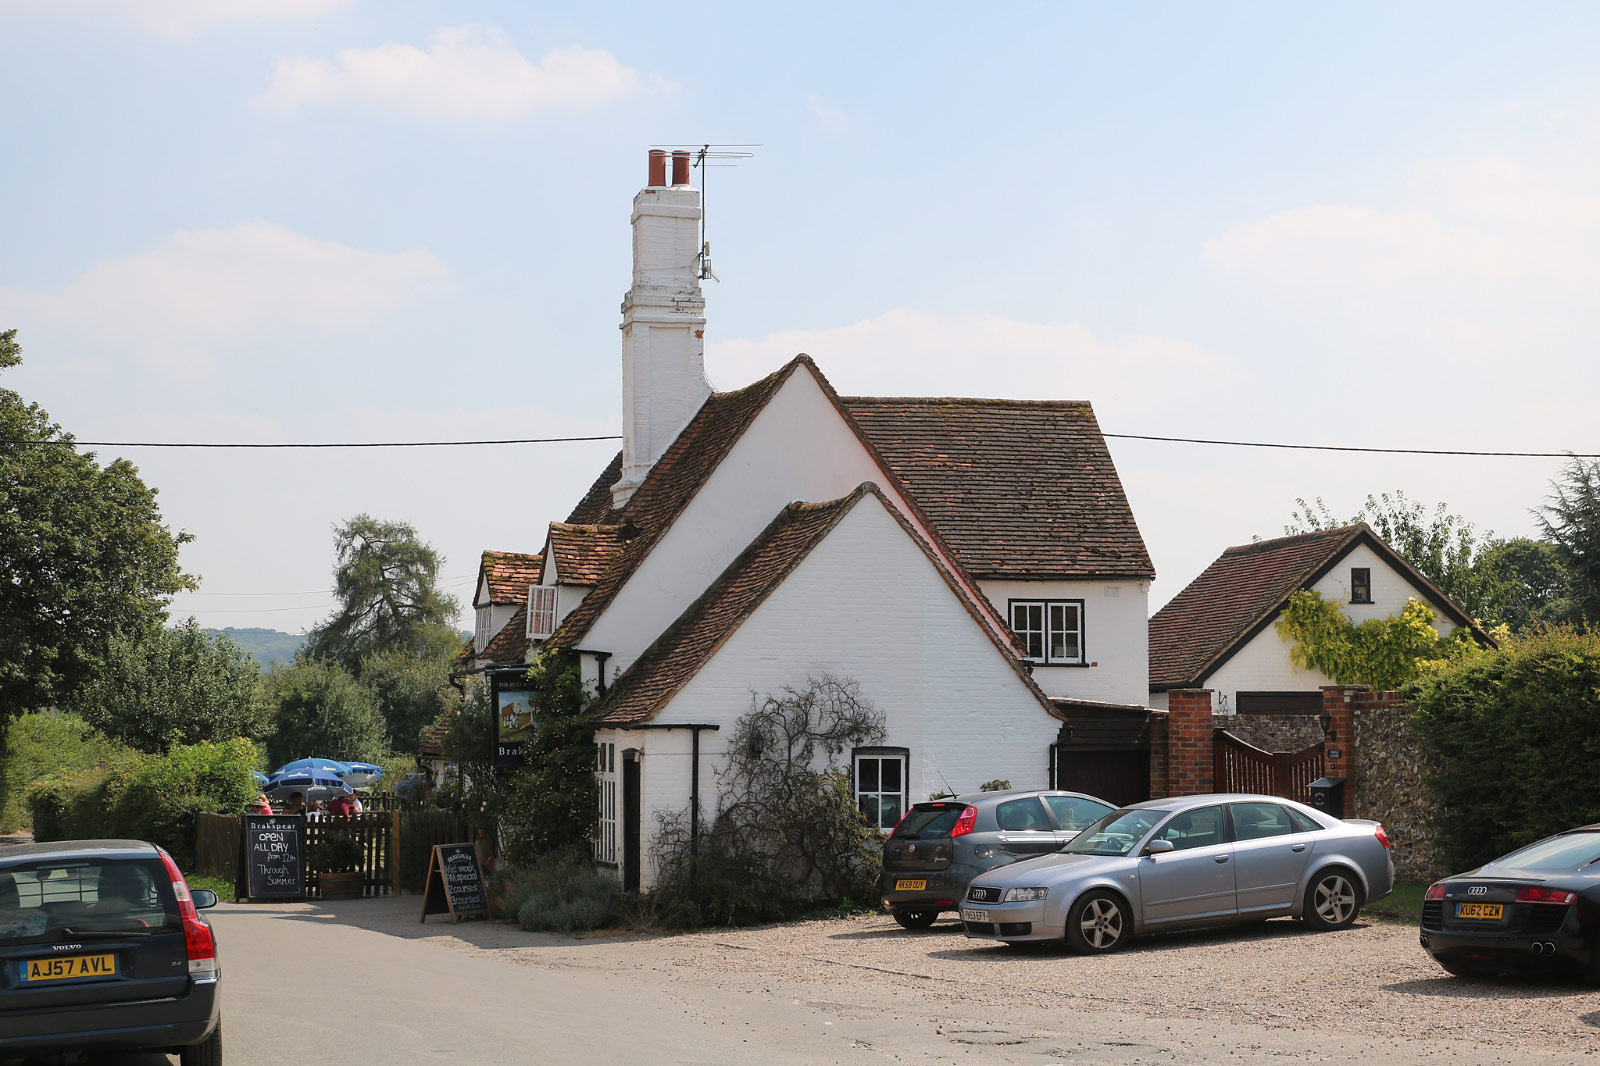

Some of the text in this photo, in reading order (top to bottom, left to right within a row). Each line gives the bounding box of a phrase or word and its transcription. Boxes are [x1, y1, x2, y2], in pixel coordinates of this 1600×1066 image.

[250, 822, 296, 831] Brakspear
[253, 843, 289, 853] ALL DAY
[266, 852, 281, 863] from
[257, 863, 289, 878] Through
[448, 884, 454, 894] 2
[450, 895, 457, 906] 3
[1460, 904, 1501, 917] KU62 CZW
[52, 943, 82, 951] VOLVO
[31, 957, 112, 977] AJ57 AVL
